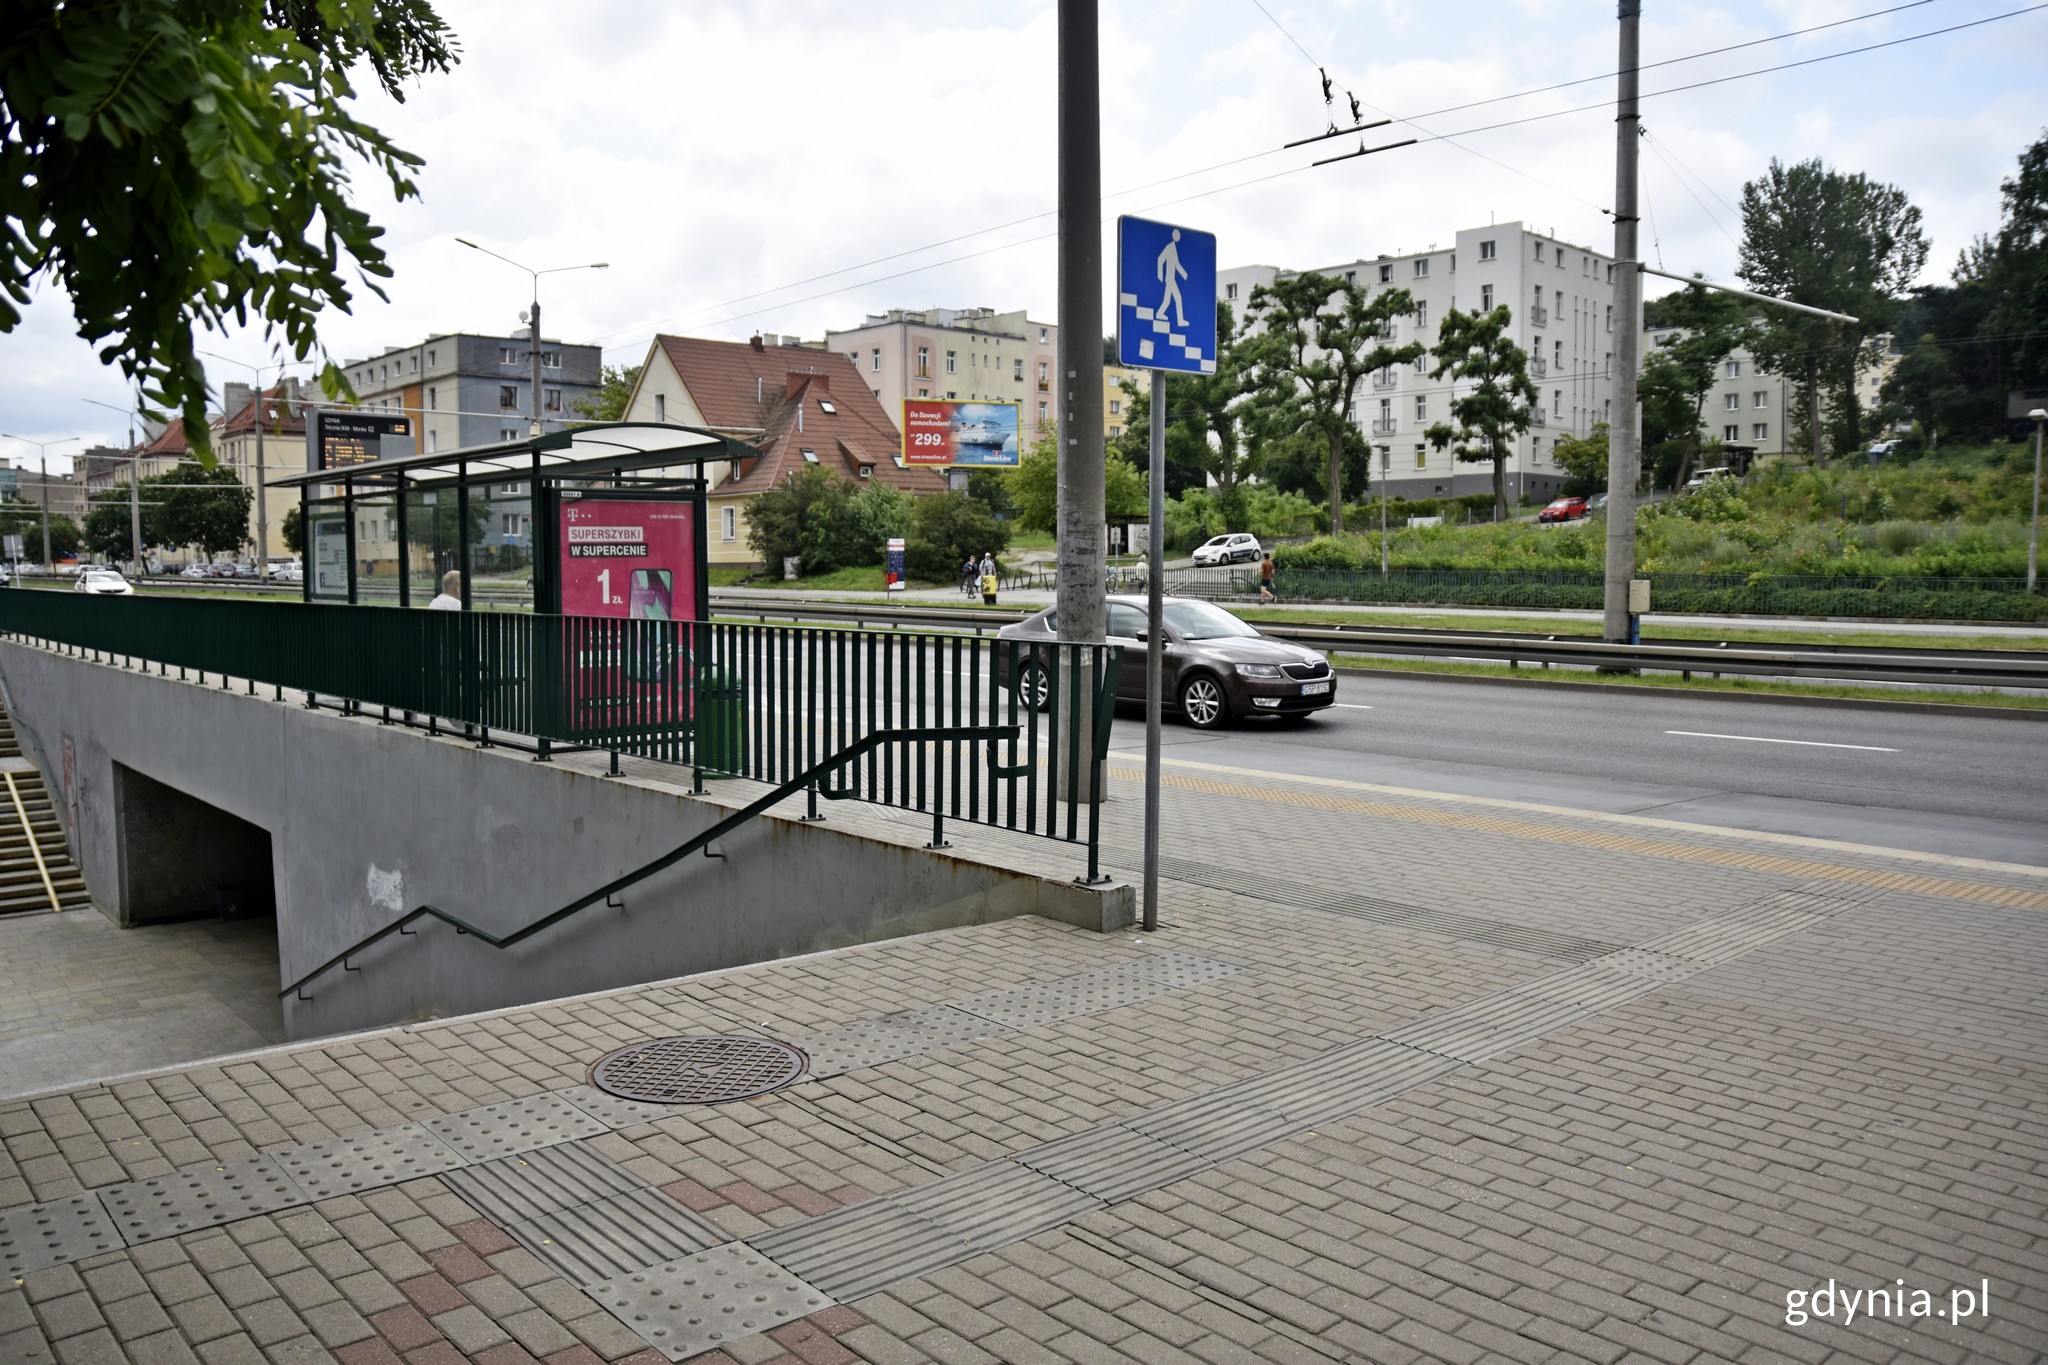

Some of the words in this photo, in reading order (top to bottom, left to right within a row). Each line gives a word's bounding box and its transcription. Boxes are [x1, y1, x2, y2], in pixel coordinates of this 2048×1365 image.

[915, 433, 941, 446] 299
[571, 529, 640, 539] SUPERSZYBKI
[571, 545, 580, 556] W
[583, 545, 646, 556] SUPERCENIE
[597, 569, 610, 604] 1
[612, 596, 623, 604] ZŁ
